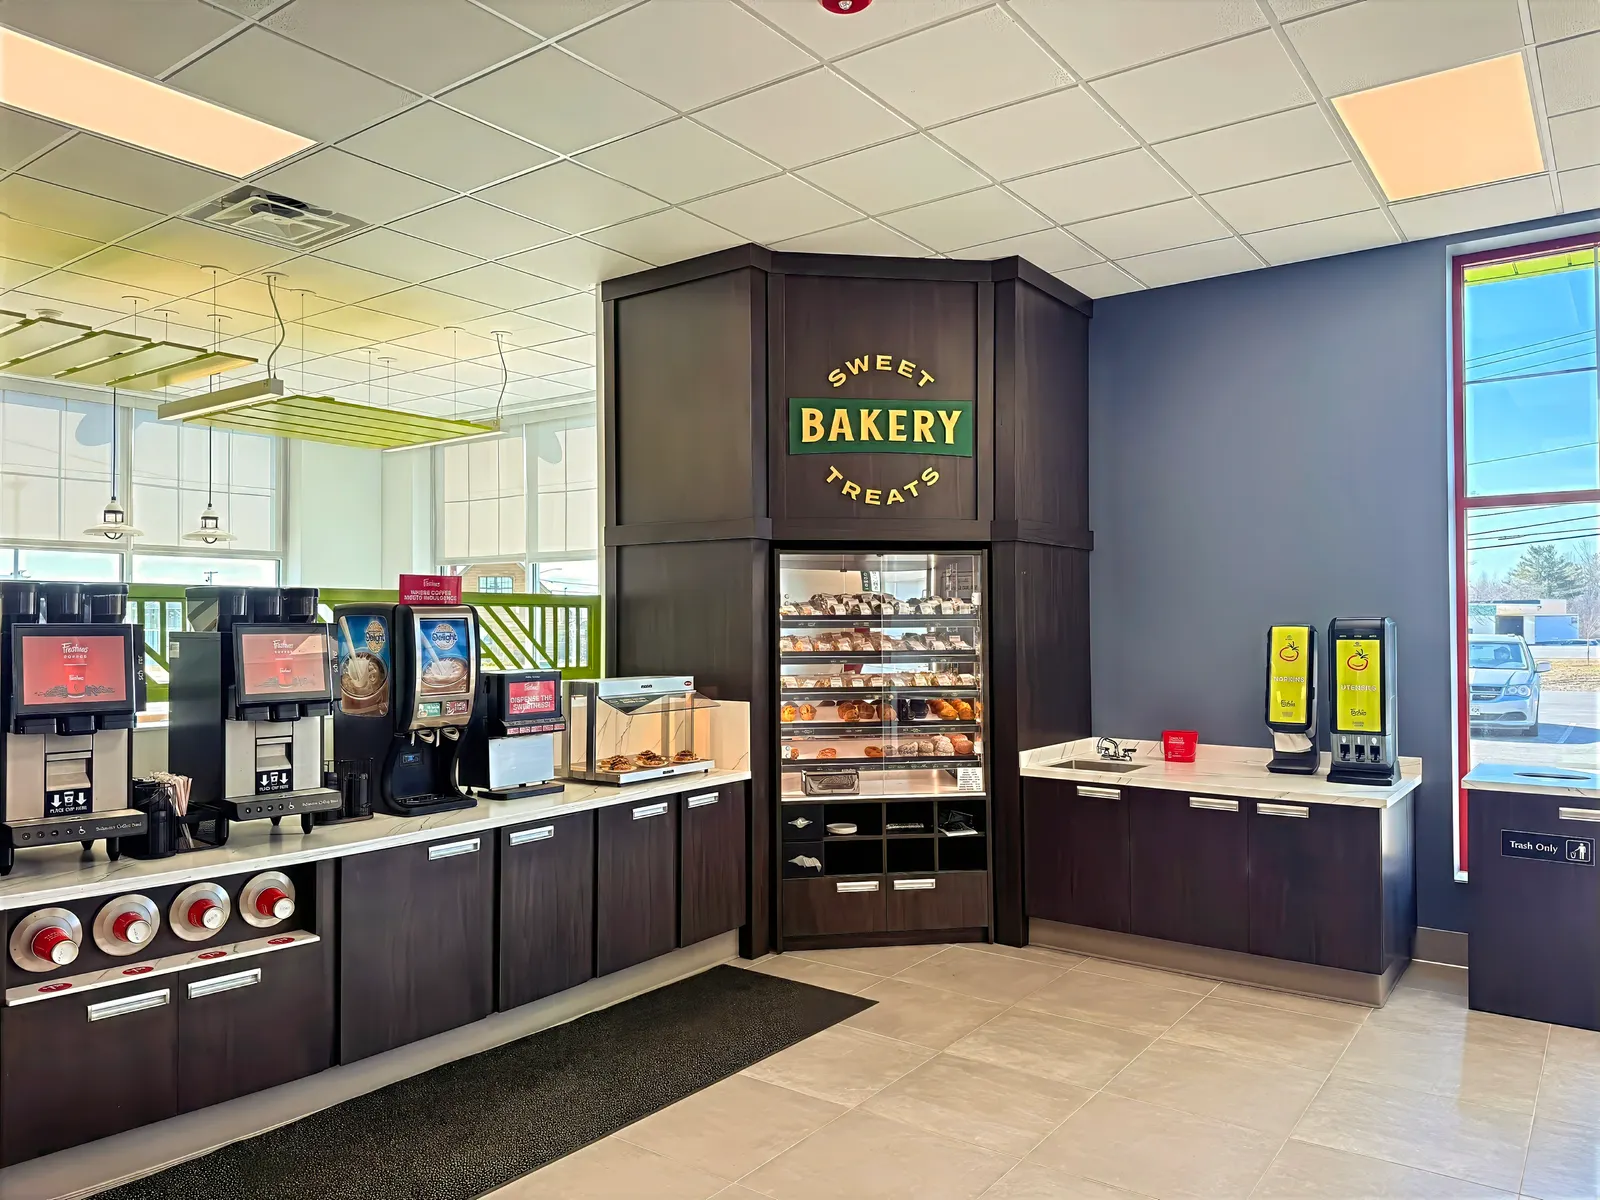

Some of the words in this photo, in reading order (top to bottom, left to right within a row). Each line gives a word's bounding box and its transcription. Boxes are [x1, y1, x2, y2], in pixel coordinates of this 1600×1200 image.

[827, 354, 935, 388] SWEET
[801, 407, 963, 444] BAKERY
[826, 465, 940, 506] TREATS
[432, 631, 457, 644] Delight
[1340, 684, 1377, 692] UTENSILS
[510, 696, 540, 704] DISPENSE
[1509, 840, 1533, 850] Trash
[1535, 843, 1558, 854] Only
